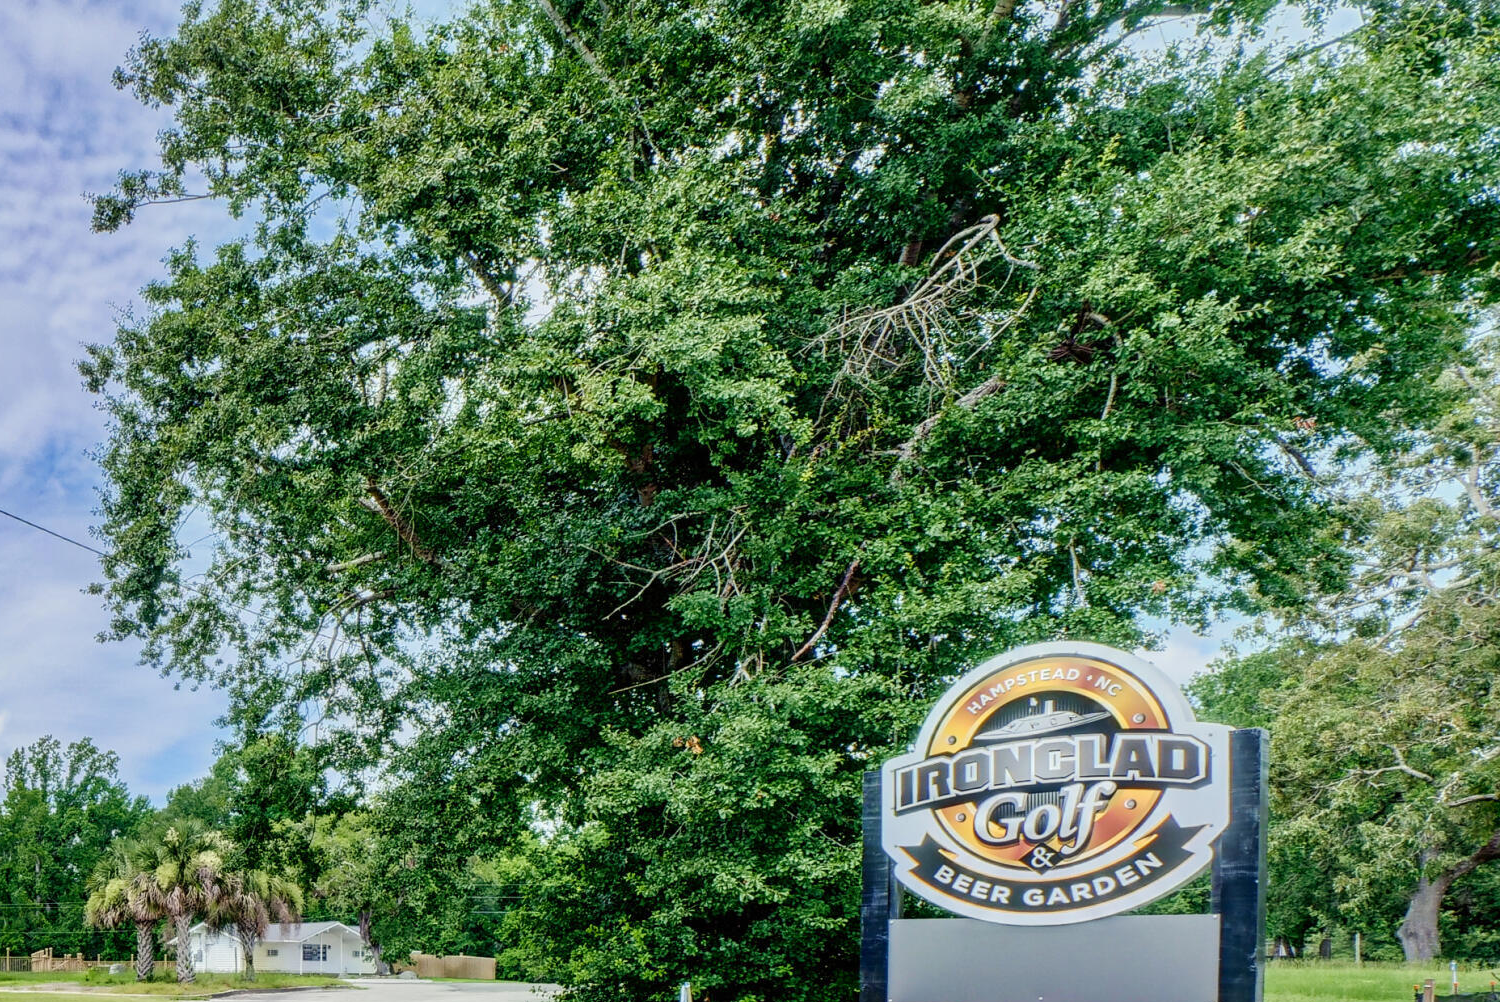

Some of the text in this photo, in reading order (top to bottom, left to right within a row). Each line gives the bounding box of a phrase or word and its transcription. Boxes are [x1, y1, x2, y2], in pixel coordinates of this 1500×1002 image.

[967, 667, 1122, 716] HAMPSTEAD NC
[896, 734, 1208, 811] IRONCLAD
[974, 781, 1117, 857] Golf
[933, 852, 1164, 907] BEER GARDEN
[1031, 846, 1056, 868] &
